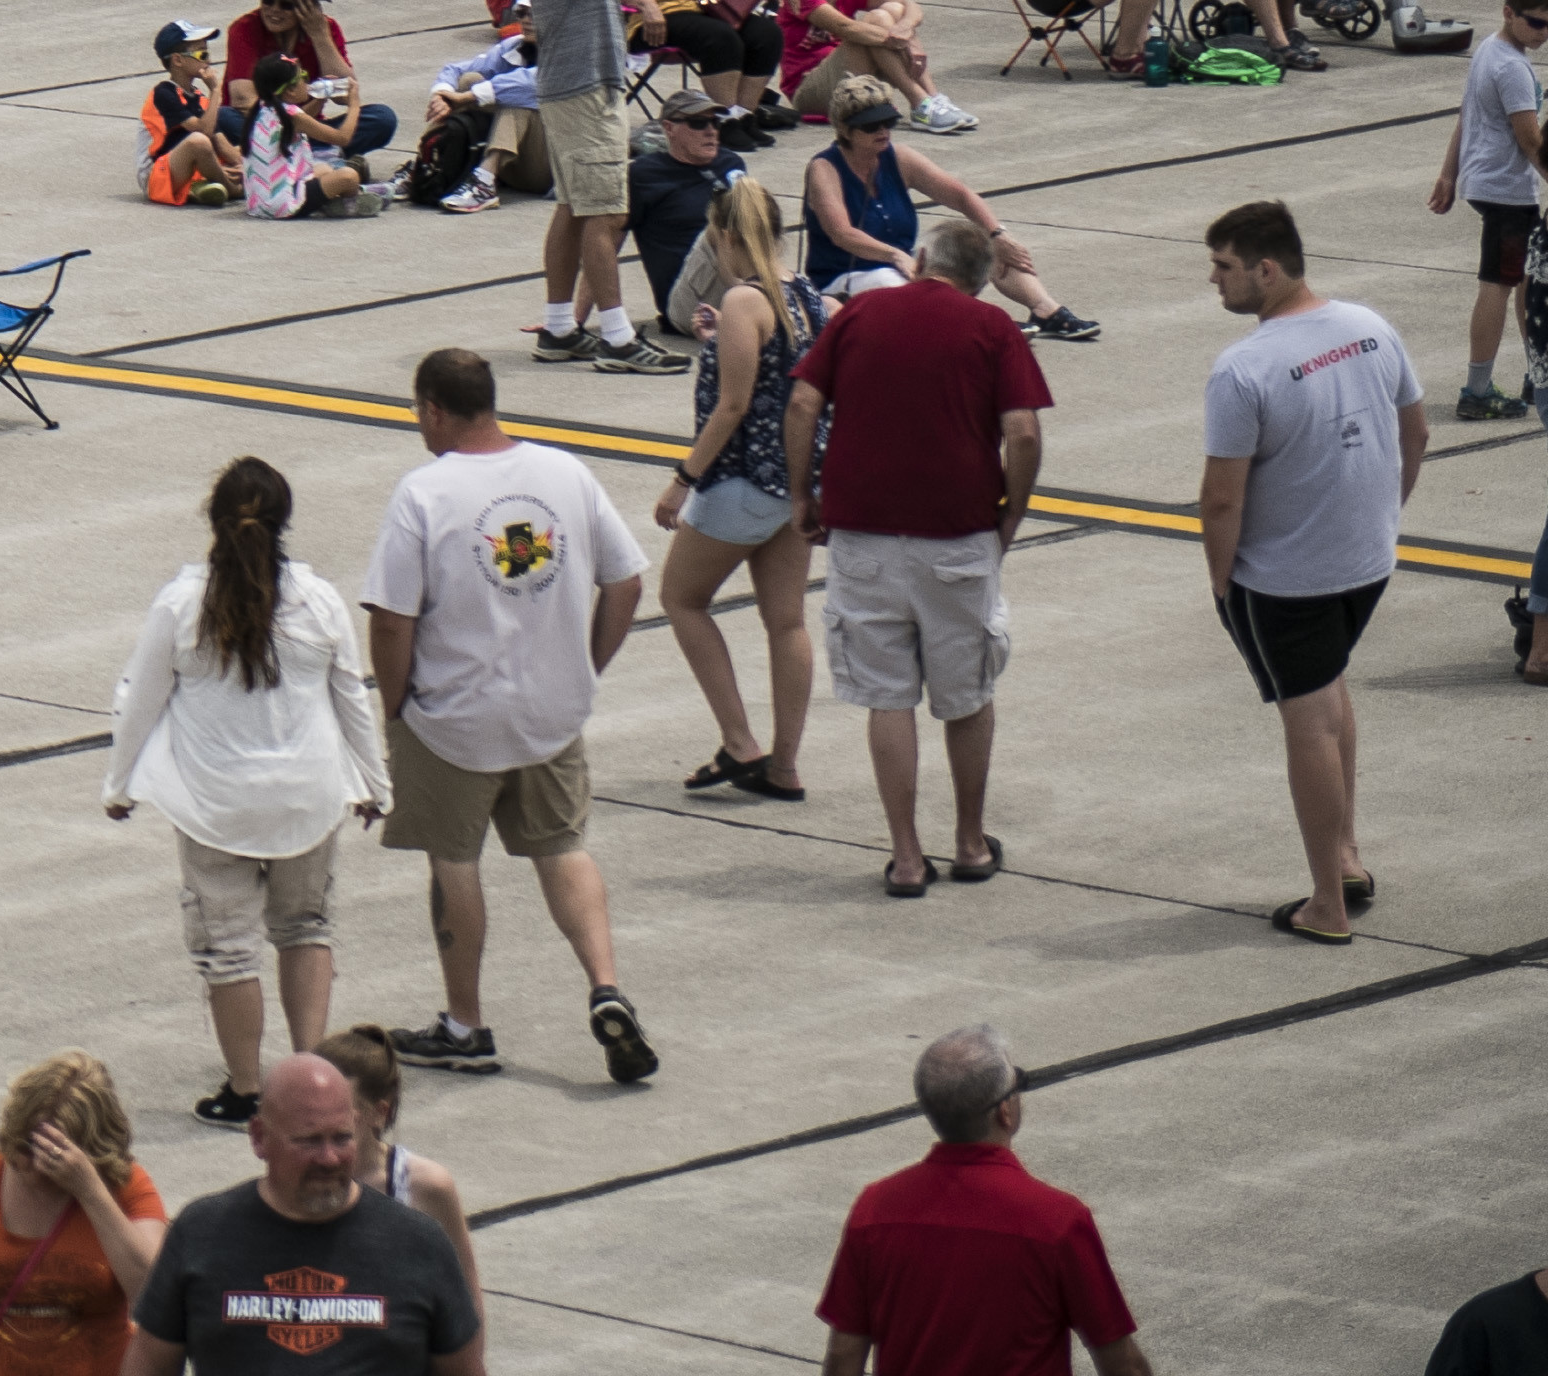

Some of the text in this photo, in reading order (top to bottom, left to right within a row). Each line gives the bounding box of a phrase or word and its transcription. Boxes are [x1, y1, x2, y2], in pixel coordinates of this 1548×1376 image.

[1290, 337, 1378, 382] UKNIGHTED
[268, 1271, 344, 1293] MOTOR
[227, 1295, 384, 1325] HARLEY-DAVIDSON
